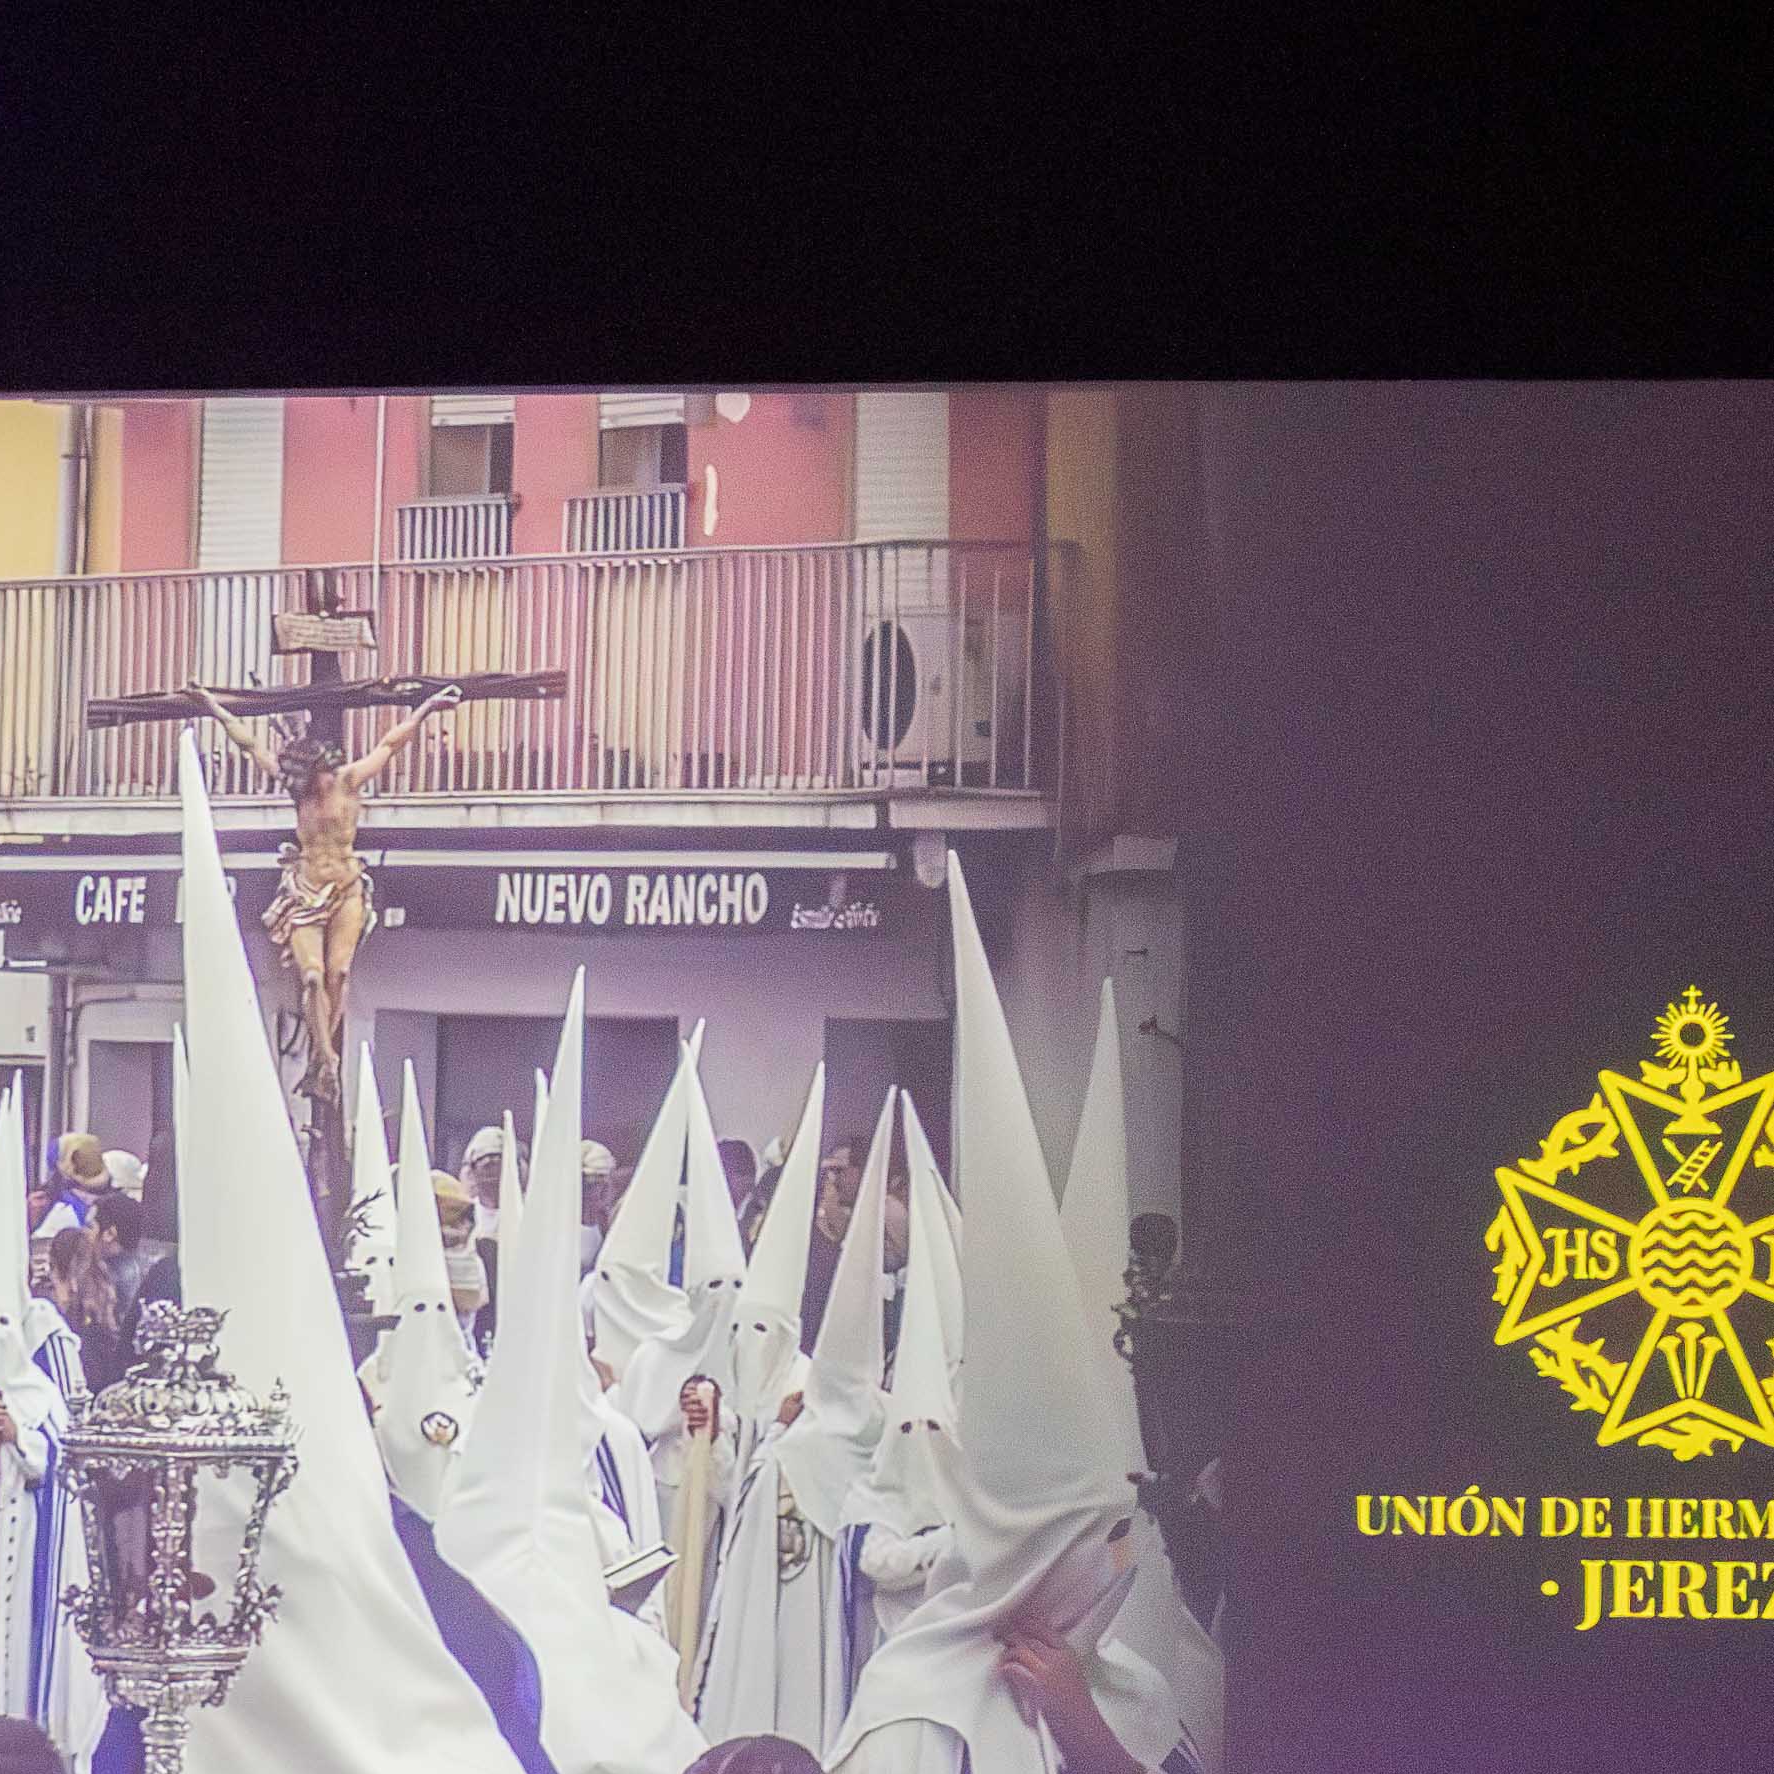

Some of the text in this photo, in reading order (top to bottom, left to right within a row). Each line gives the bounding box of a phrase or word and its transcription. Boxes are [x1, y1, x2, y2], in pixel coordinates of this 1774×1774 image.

[75, 875, 148, 925] CAFE
[495, 872, 613, 925] NUEVO
[624, 872, 770, 925] RANCHO
[1355, 1484, 1527, 1538] UNIÓN
[1540, 1496, 1613, 1539] DE
[1574, 1559, 1774, 1632] JERE
